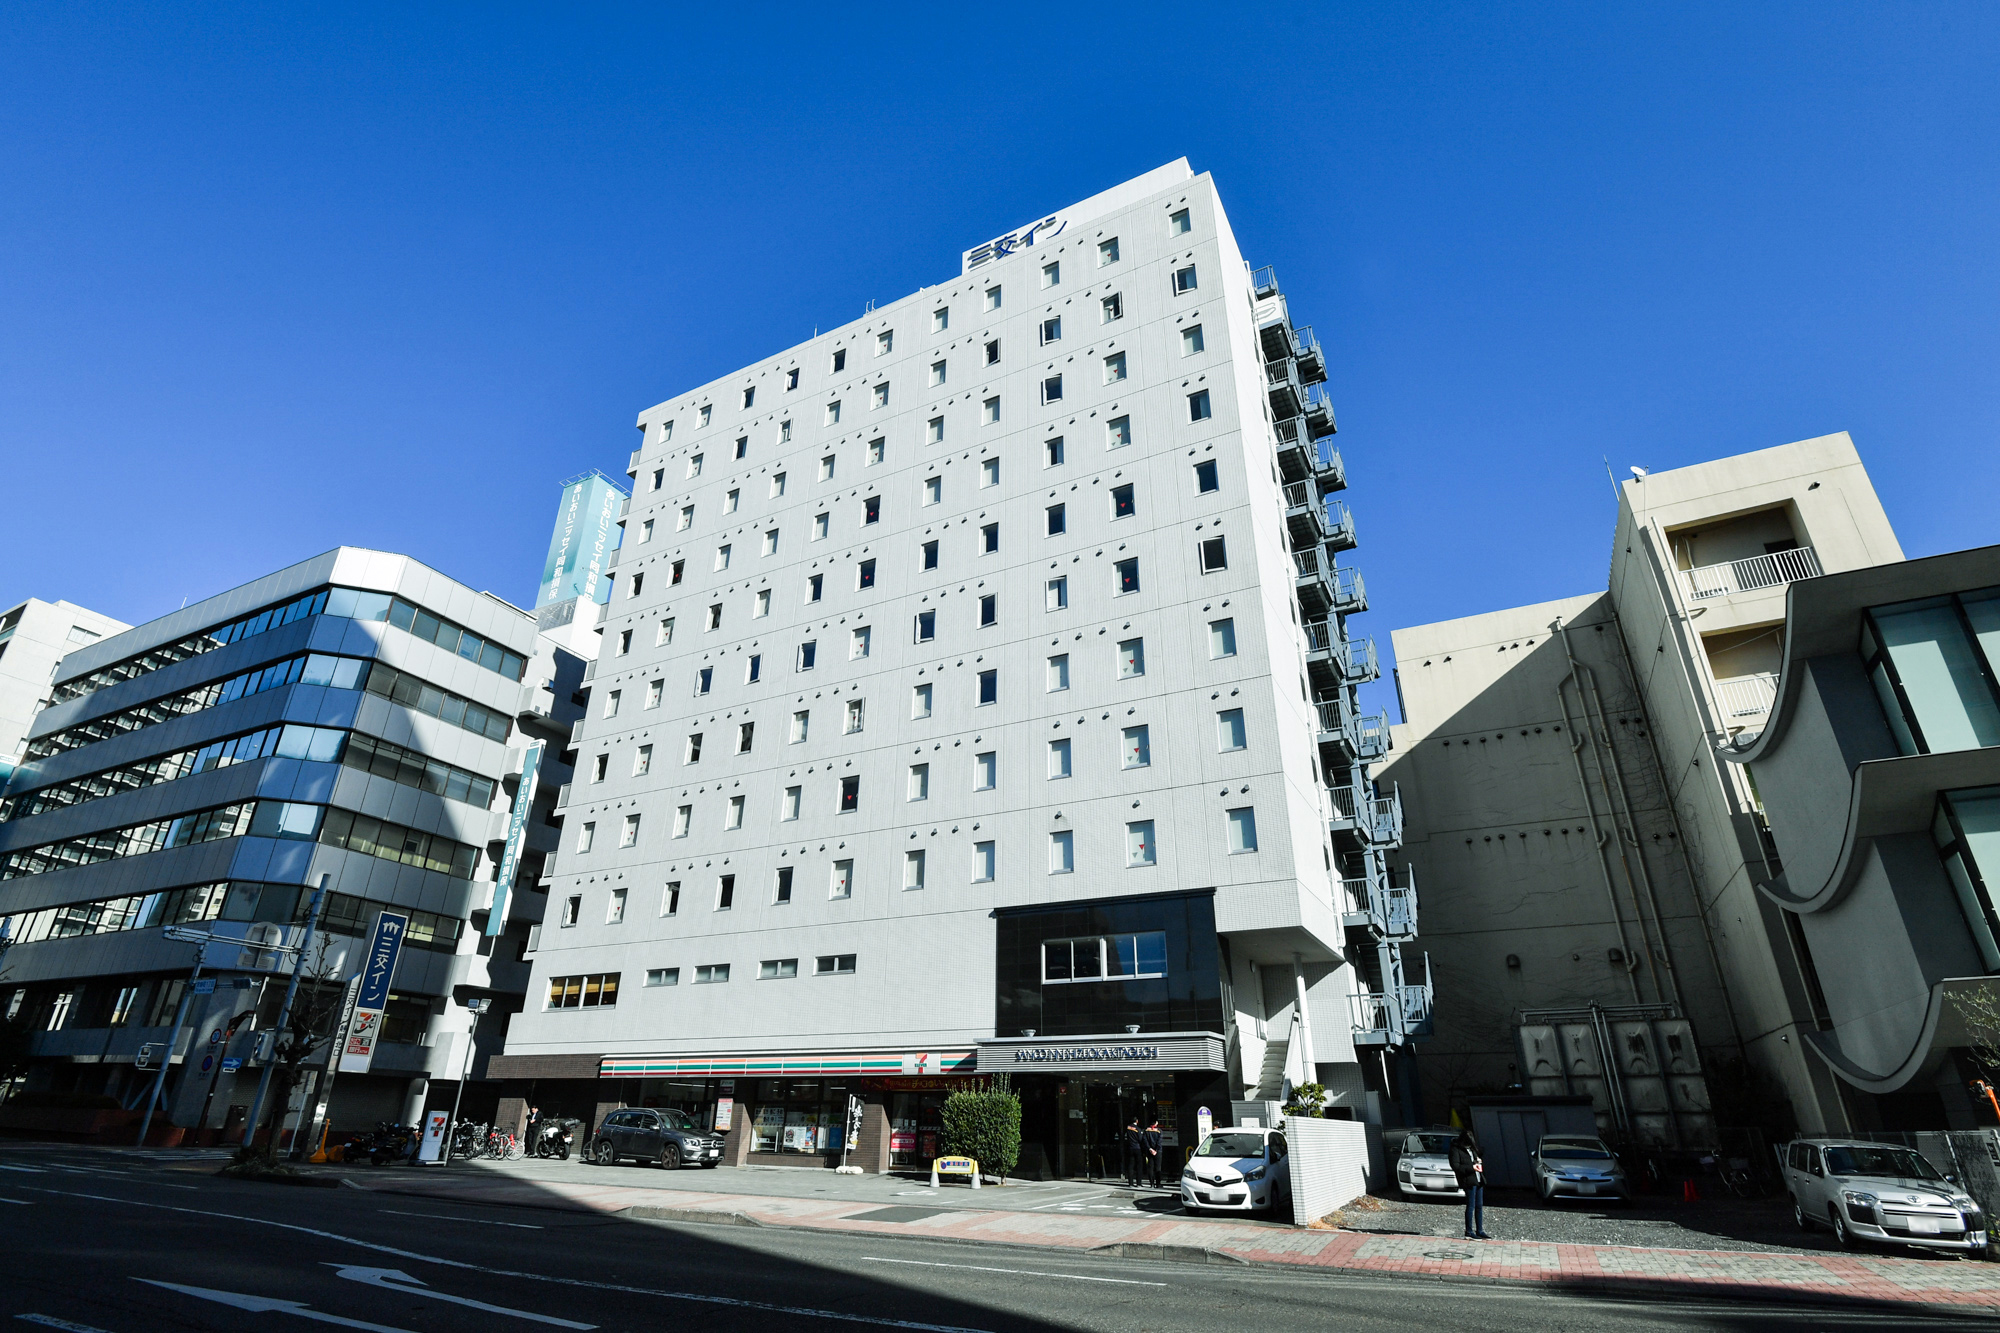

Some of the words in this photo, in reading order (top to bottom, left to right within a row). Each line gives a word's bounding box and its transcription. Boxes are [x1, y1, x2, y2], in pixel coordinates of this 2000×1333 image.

[968, 216, 1067, 271] 三交イン
[549, 483, 582, 600] あいおいニッセイ同和損保
[367, 936, 393, 1001] 三交イン
